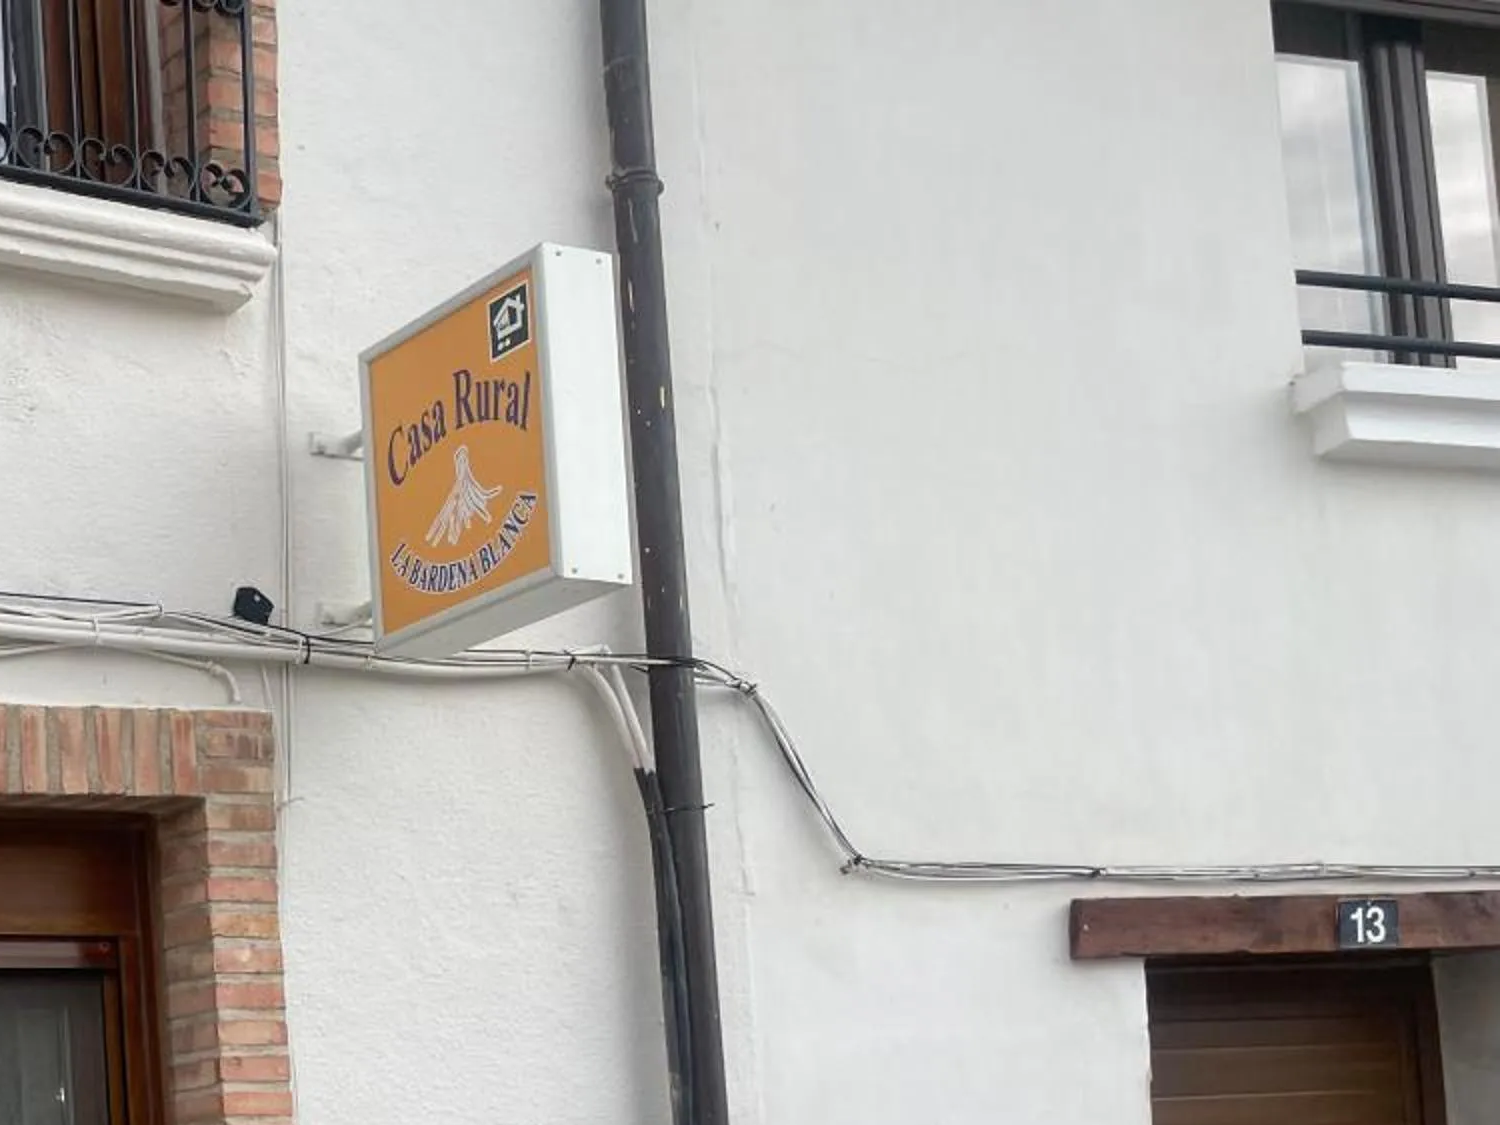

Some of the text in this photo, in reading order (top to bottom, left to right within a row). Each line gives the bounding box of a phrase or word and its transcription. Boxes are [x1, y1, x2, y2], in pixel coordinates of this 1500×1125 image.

[387, 368, 532, 486] Casa Rural
[391, 493, 537, 593] LA BARDENA BLANCA
[1350, 906, 1386, 943] 13
